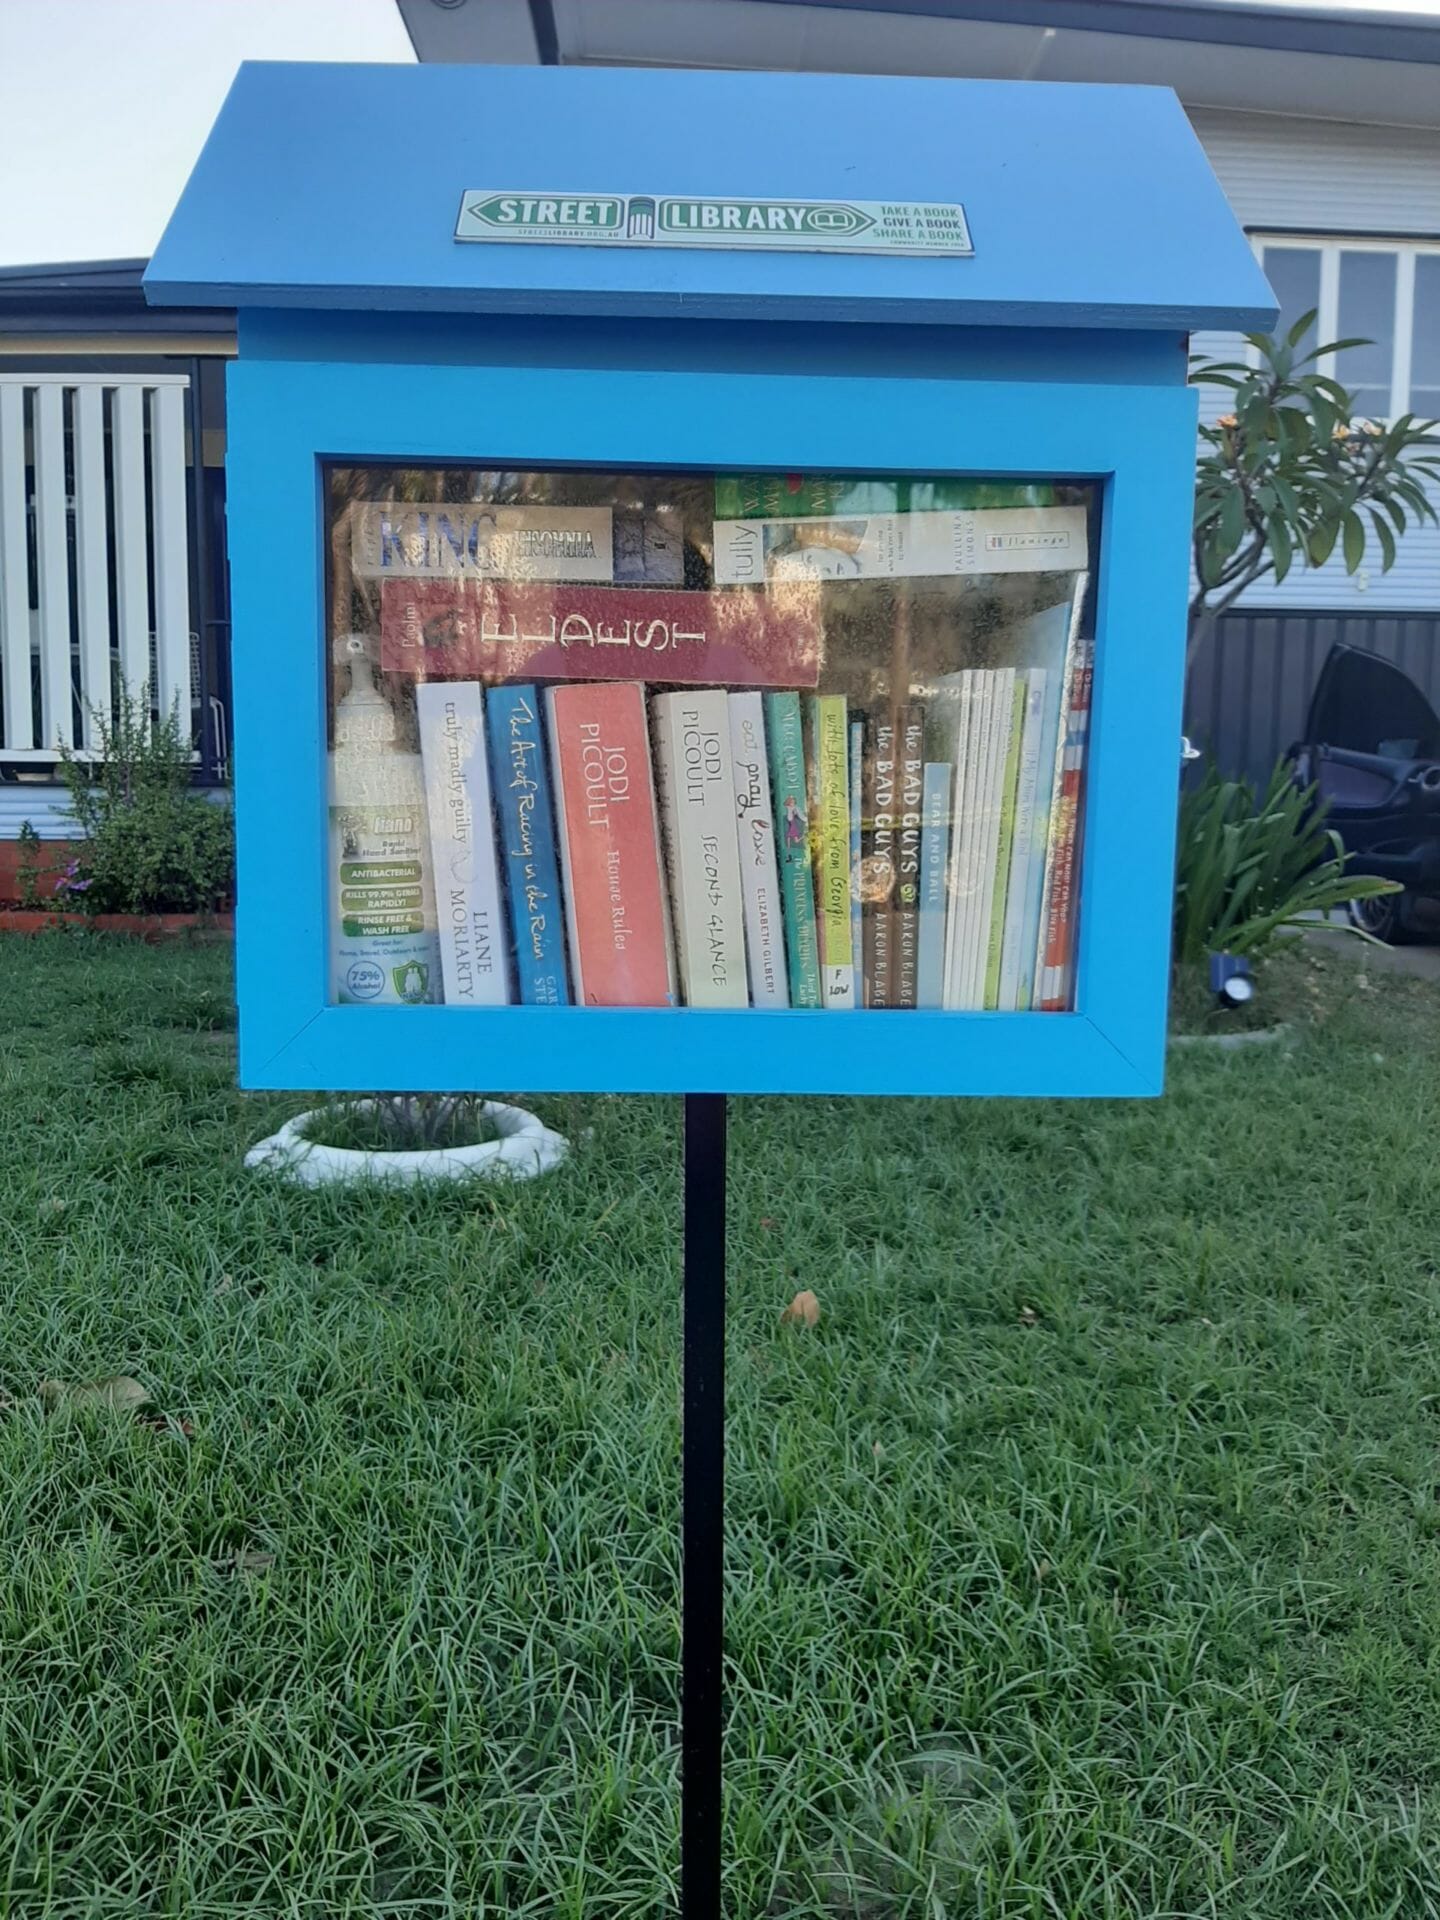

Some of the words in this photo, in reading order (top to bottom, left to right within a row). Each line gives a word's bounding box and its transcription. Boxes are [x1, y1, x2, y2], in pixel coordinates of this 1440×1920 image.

[498, 200, 613, 225] STREET
[670, 204, 807, 230] LIBRARY
[881, 206, 909, 215] TAKE
[913, 208, 920, 216] A
[924, 208, 958, 217] BOOK
[883, 218, 912, 227] GIVE
[916, 219, 923, 227] A
[927, 219, 960, 229] BOOK
[873, 229, 914, 238] SHARE
[918, 231, 925, 239] A
[929, 231, 963, 240] BOOK
[729, 525, 758, 578] tully
[954, 514, 963, 571] PAULLINA
[966, 520, 975, 565] SIMONS
[481, 612, 707, 651] ELDEST
[443, 702, 461, 740] truly
[509, 697, 533, 736] The
[826, 714, 841, 744] with
[511, 740, 536, 769] Art
[741, 720, 755, 753] eat
[877, 725, 891, 753] the
[905, 725, 920, 753] the
[446, 745, 468, 794] madly
[603, 746, 630, 802] JODI
[683, 710, 704, 807] PICOULT
[700, 731, 722, 782] JODI
[784, 745, 800, 790] CABOT
[827, 744, 839, 775] lots
[511, 769, 538, 791] of
[580, 723, 609, 830] PICOULT
[737, 761, 762, 819] pray
[830, 783, 846, 798] of
[875, 760, 894, 806] BAD
[903, 760, 923, 806] BAD
[449, 799, 473, 844] guilty
[511, 794, 536, 856] Racing
[829, 805, 844, 830] love
[929, 792, 942, 829] BEAR
[750, 819, 769, 867] love
[830, 836, 845, 869] from
[873, 813, 893, 875] GUYS
[900, 813, 920, 874] GUYS
[929, 834, 941, 863] AND
[351, 868, 415, 878] ANTIBACTERIAL
[524, 863, 539, 879] in
[607, 850, 624, 901] House
[701, 835, 724, 906] SECOND
[928, 870, 939, 902] BALL
[526, 884, 548, 912] the
[757, 888, 770, 946] ELIZABETH
[826, 876, 846, 927] Georgia
[358, 916, 384, 924] RINSE
[386, 914, 405, 923] FREE
[362, 927, 389, 935] WASH
[391, 925, 410, 933] FREE
[532, 915, 548, 960] Rain
[612, 906, 632, 950] Rules
[874, 912, 887, 957] AARON
[901, 912, 914, 958] AARON
[449, 889, 474, 999] MORIARTY
[473, 911, 492, 974] LIANE
[708, 914, 727, 987] GLANCE
[351, 970, 380, 981] 75%
[534, 978, 547, 1005] STE
[547, 976, 558, 1006] GAR
[763, 950, 774, 995] GILBERT
[807, 974, 816, 993] Third
[829, 984, 849, 996] LOW
[835, 969, 842, 980] F
[799, 984, 808, 1004] Lucky
